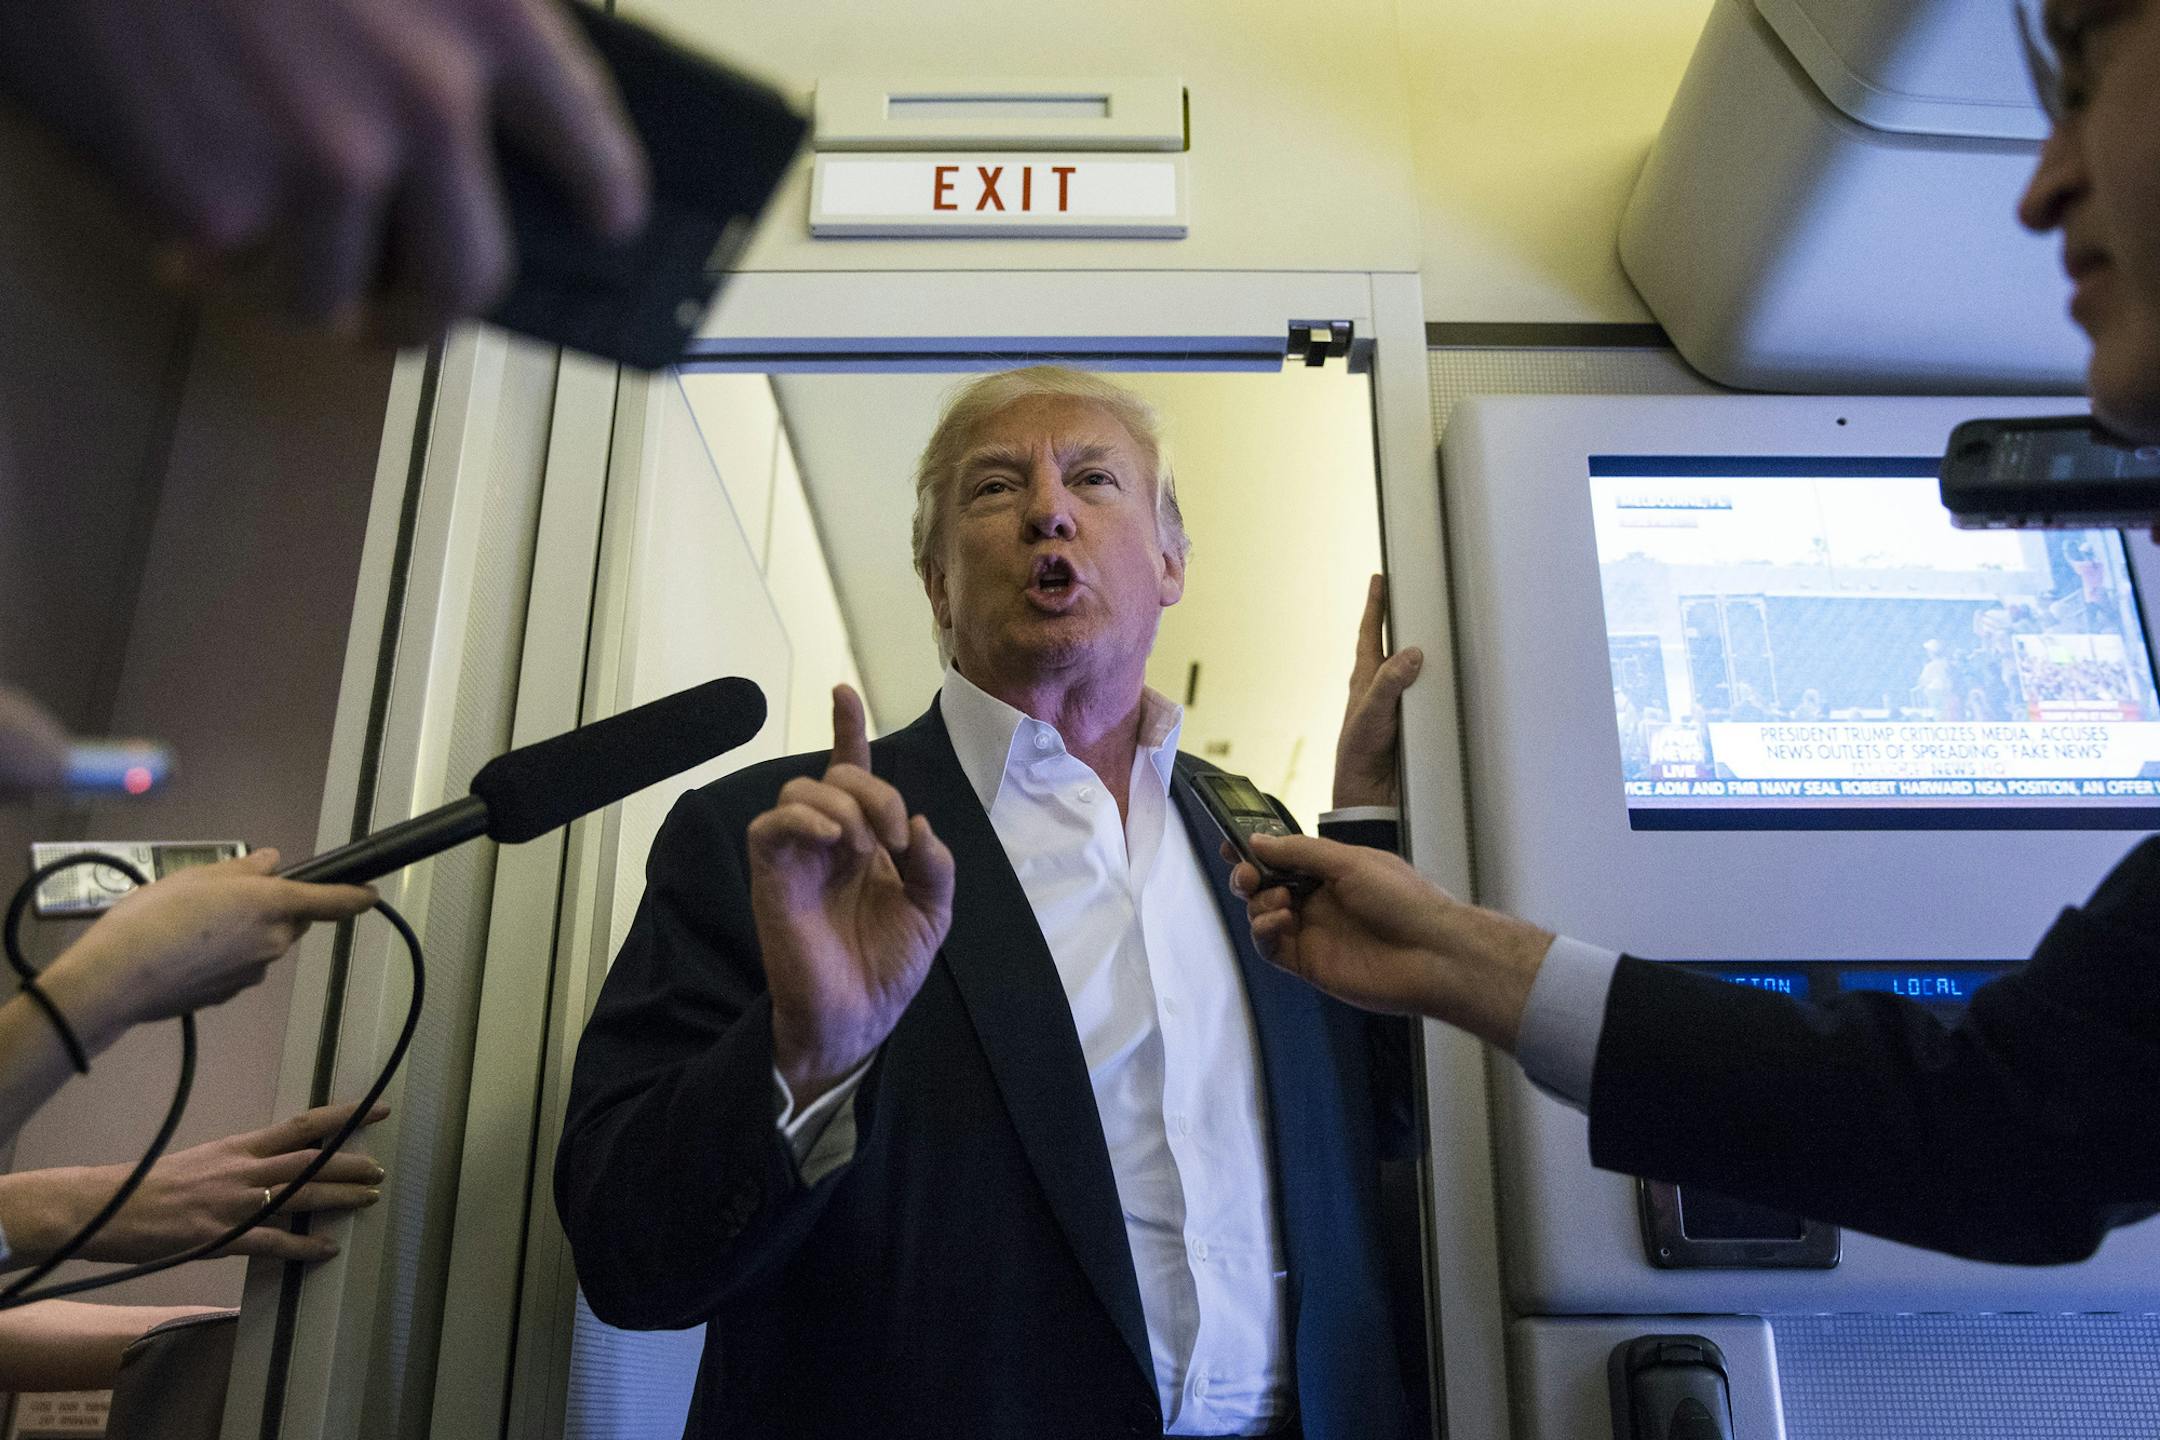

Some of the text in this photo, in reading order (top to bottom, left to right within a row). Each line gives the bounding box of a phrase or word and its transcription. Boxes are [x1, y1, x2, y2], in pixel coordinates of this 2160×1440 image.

[933, 166, 1076, 211] EXIT
[1760, 727, 1838, 741] PRESIDENT
[1843, 727, 1894, 741] TRUMP
[1899, 727, 1976, 741] CRITICIZES
[2040, 727, 2109, 741] ACCUSES
[1767, 744, 1812, 759] NEWS
[1816, 744, 1882, 759] OUTLETS
[1886, 744, 1906, 759] OF
[1911, 744, 1999, 759] SPREADING
[1662, 765, 1697, 778] LIVE
[1655, 781, 1690, 795] ADM
[1692, 781, 1726, 795] AND
[1728, 781, 1758, 795] FMR
[1760, 781, 1802, 795] NAVY
[1803, 781, 1841, 795] SEAL
[1842, 781, 1897, 795] ROBERT
[1900, 781, 1973, 795] HARWARD
[1975, 781, 2006, 795] NSA
[2007, 781, 2079, 796] POSITION,
[2083, 781, 2105, 795] AN
[2106, 781, 2153, 795] OFFER
[1893, 978, 1963, 995] LOCAL
